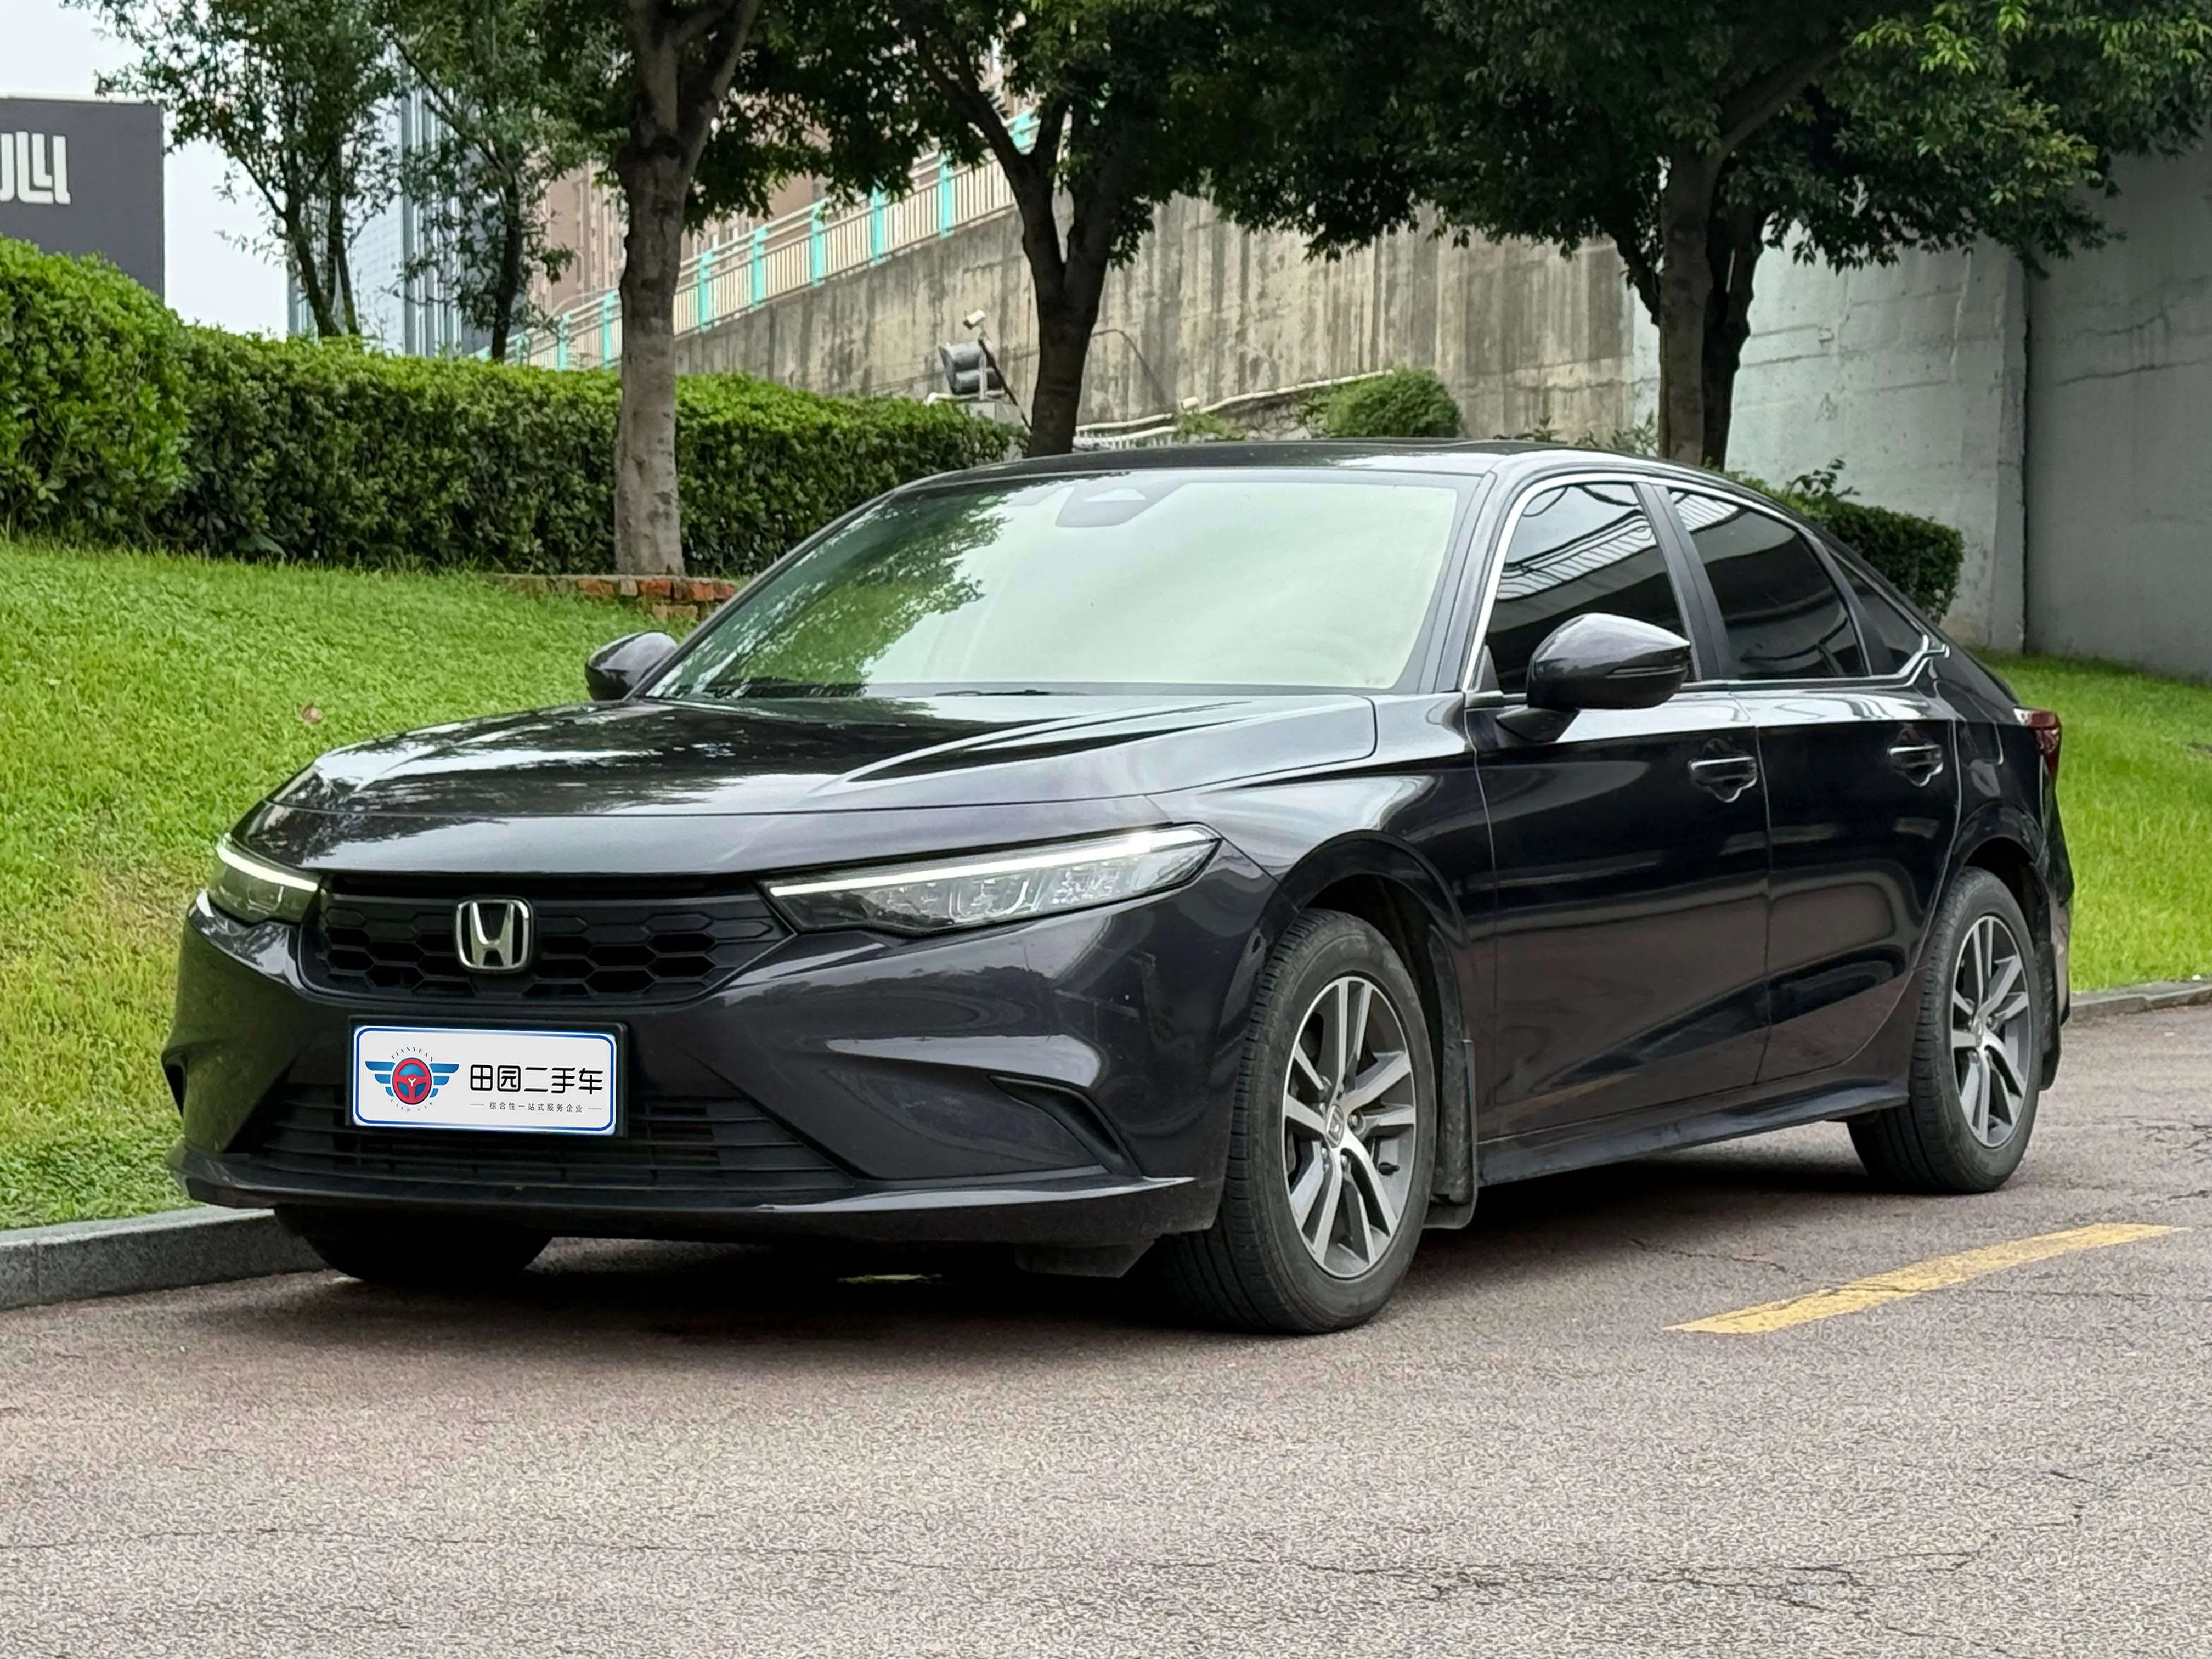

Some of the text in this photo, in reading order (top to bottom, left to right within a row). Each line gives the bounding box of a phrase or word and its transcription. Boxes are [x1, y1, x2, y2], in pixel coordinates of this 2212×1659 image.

[470, 1064, 603, 1094] 田园二手车
[489, 1101, 583, 1113] 综合性一站式服务企业
